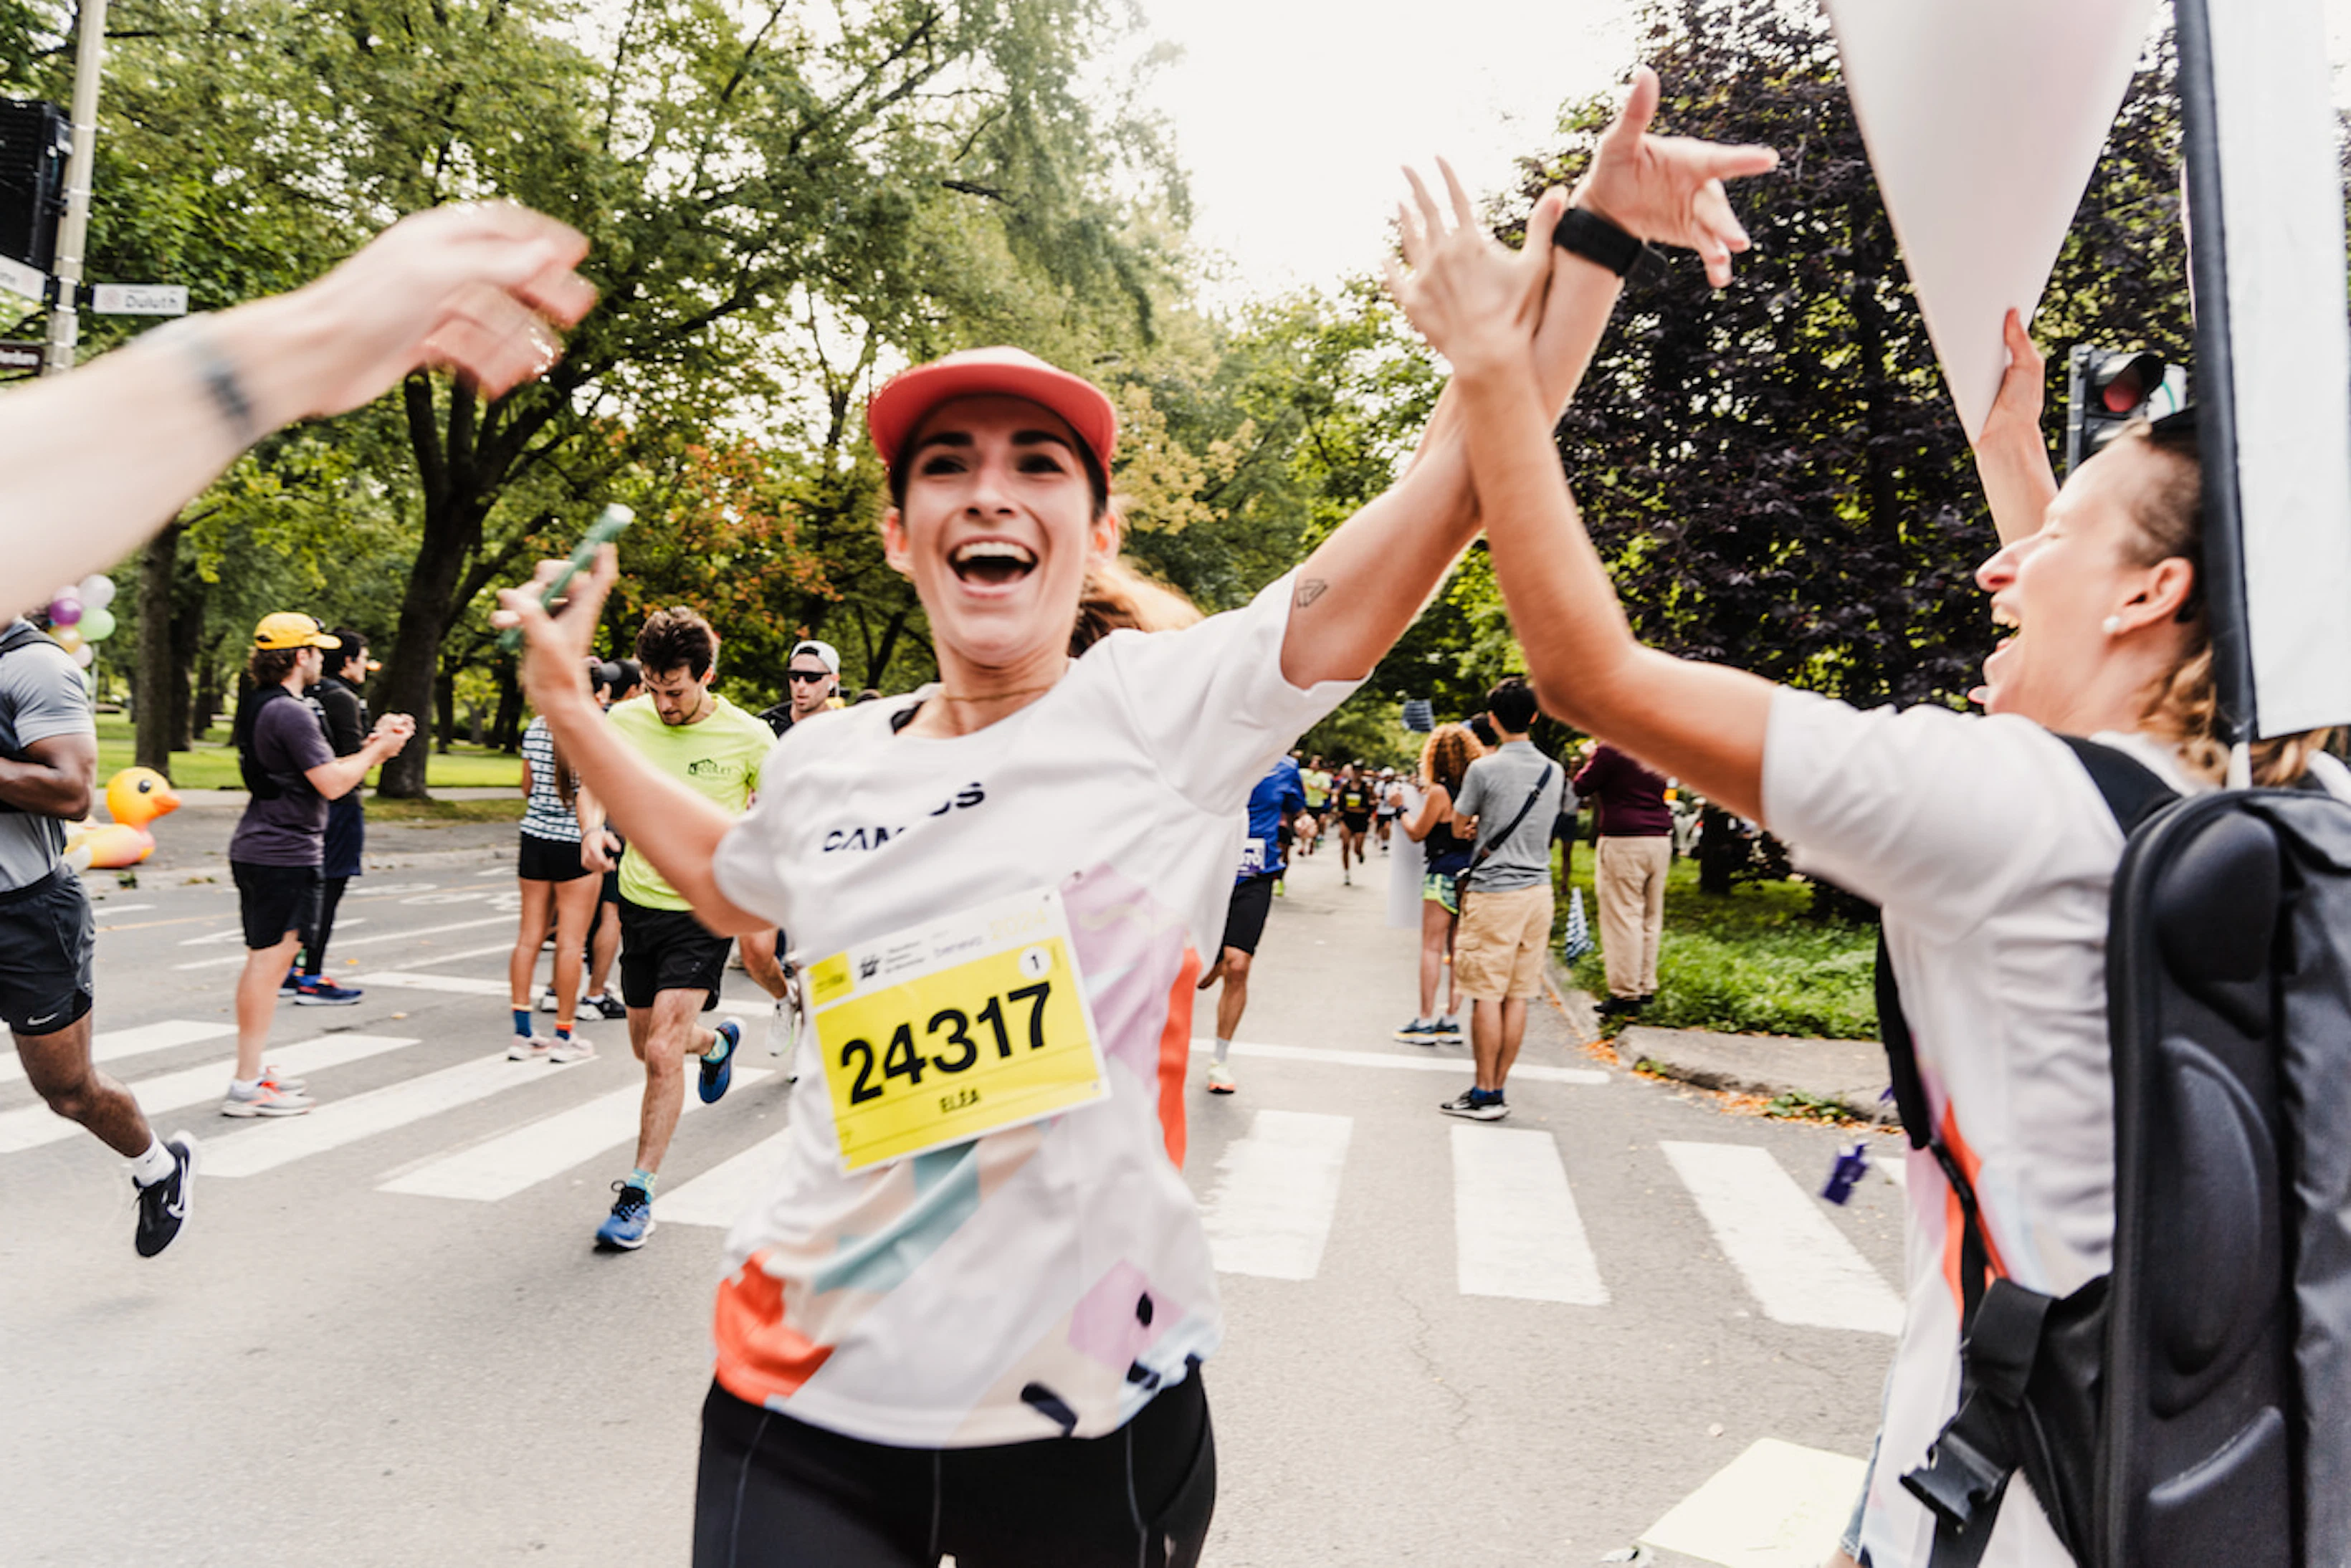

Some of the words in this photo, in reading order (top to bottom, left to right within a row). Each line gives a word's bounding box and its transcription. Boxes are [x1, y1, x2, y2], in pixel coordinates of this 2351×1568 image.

[125, 295, 178, 308] Duluth
[1031, 953, 1039, 970] 1
[841, 980, 1050, 1106] 24317
